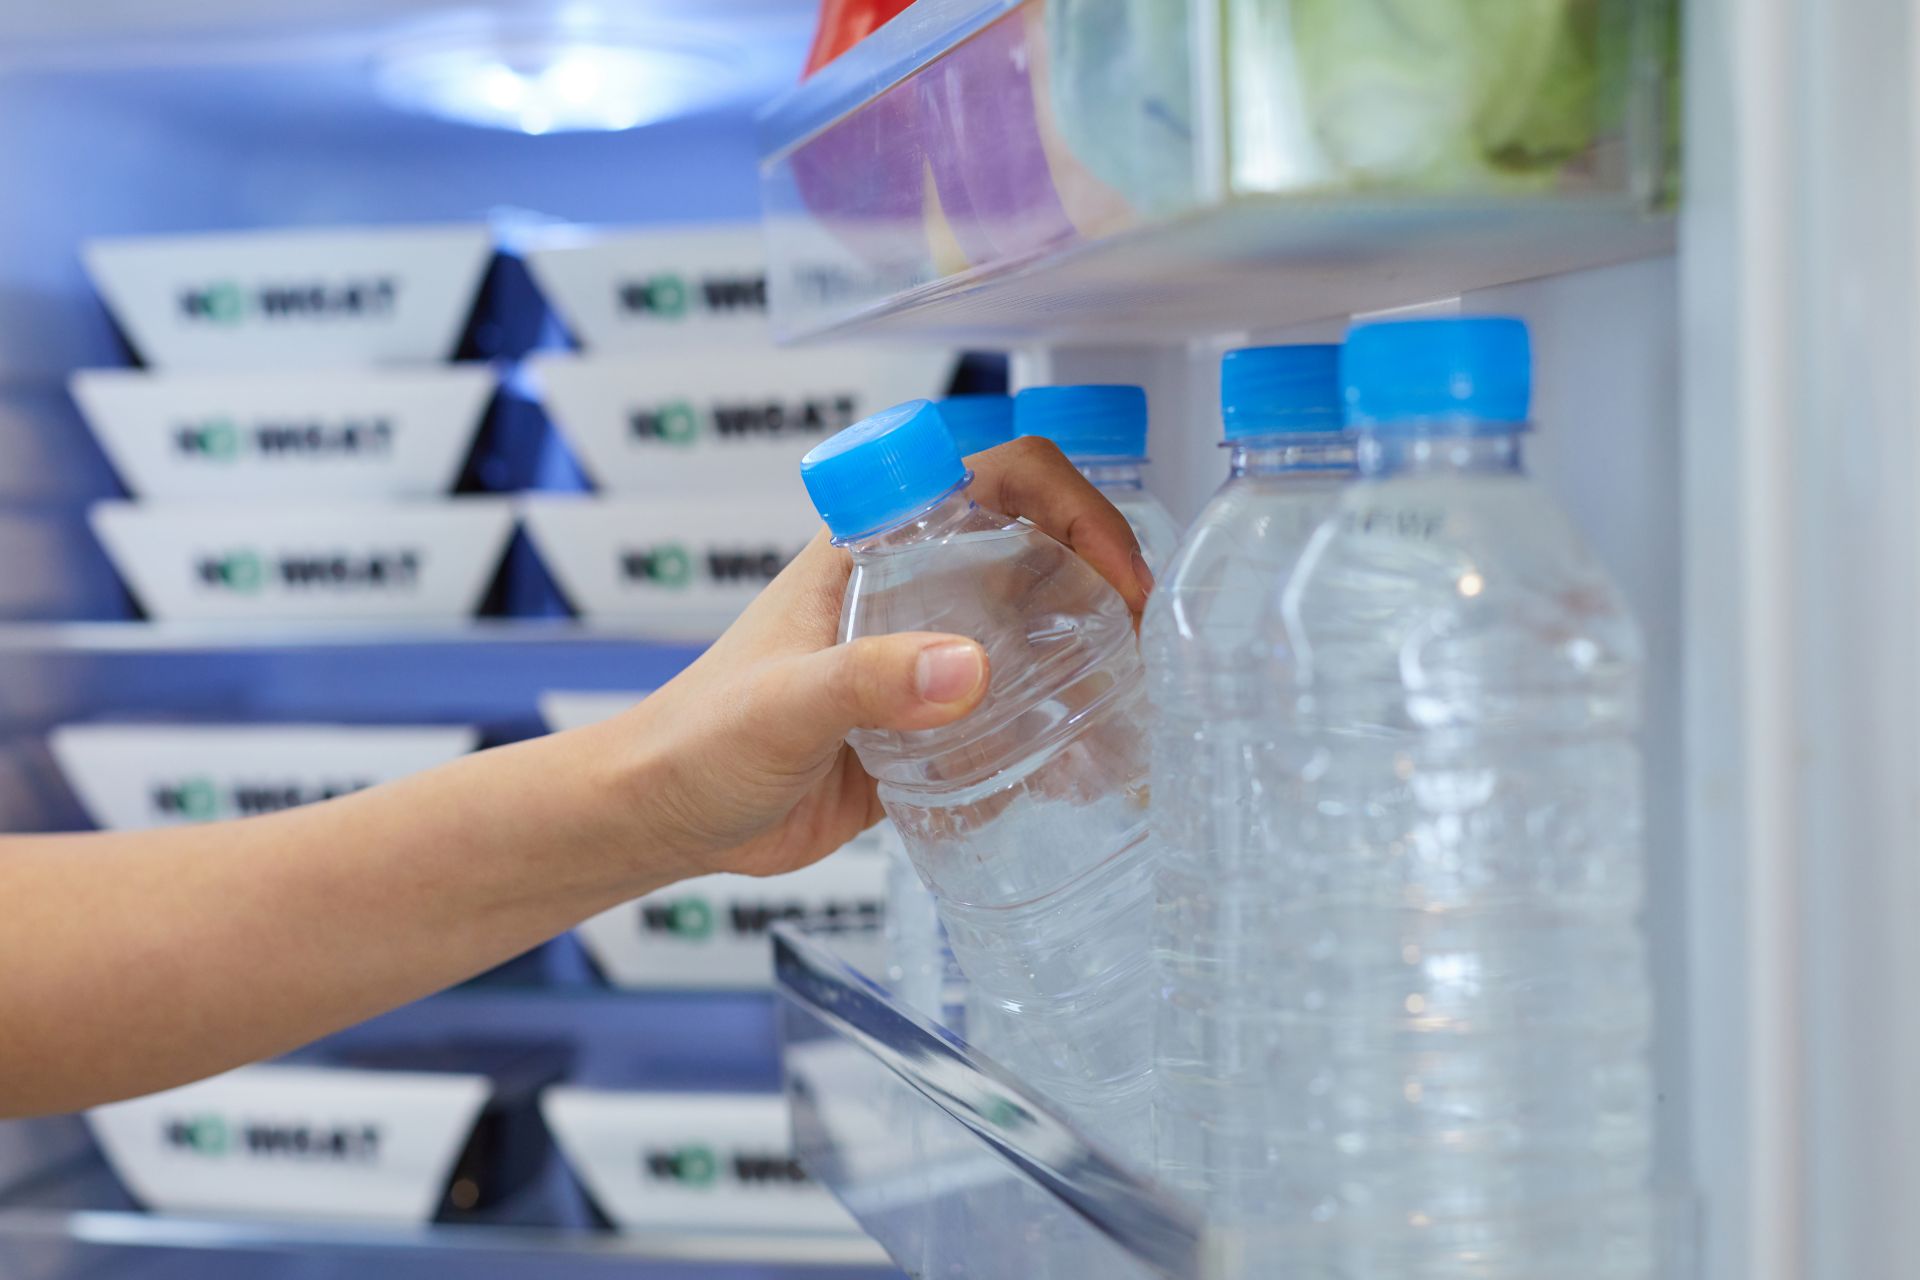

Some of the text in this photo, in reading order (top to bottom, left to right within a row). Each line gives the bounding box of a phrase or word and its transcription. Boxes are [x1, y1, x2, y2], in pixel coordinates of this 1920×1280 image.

[700, 274, 767, 318] ME
[705, 546, 784, 587] ME
[231, 778, 374, 818] ME
[731, 1149, 808, 1184] ME
